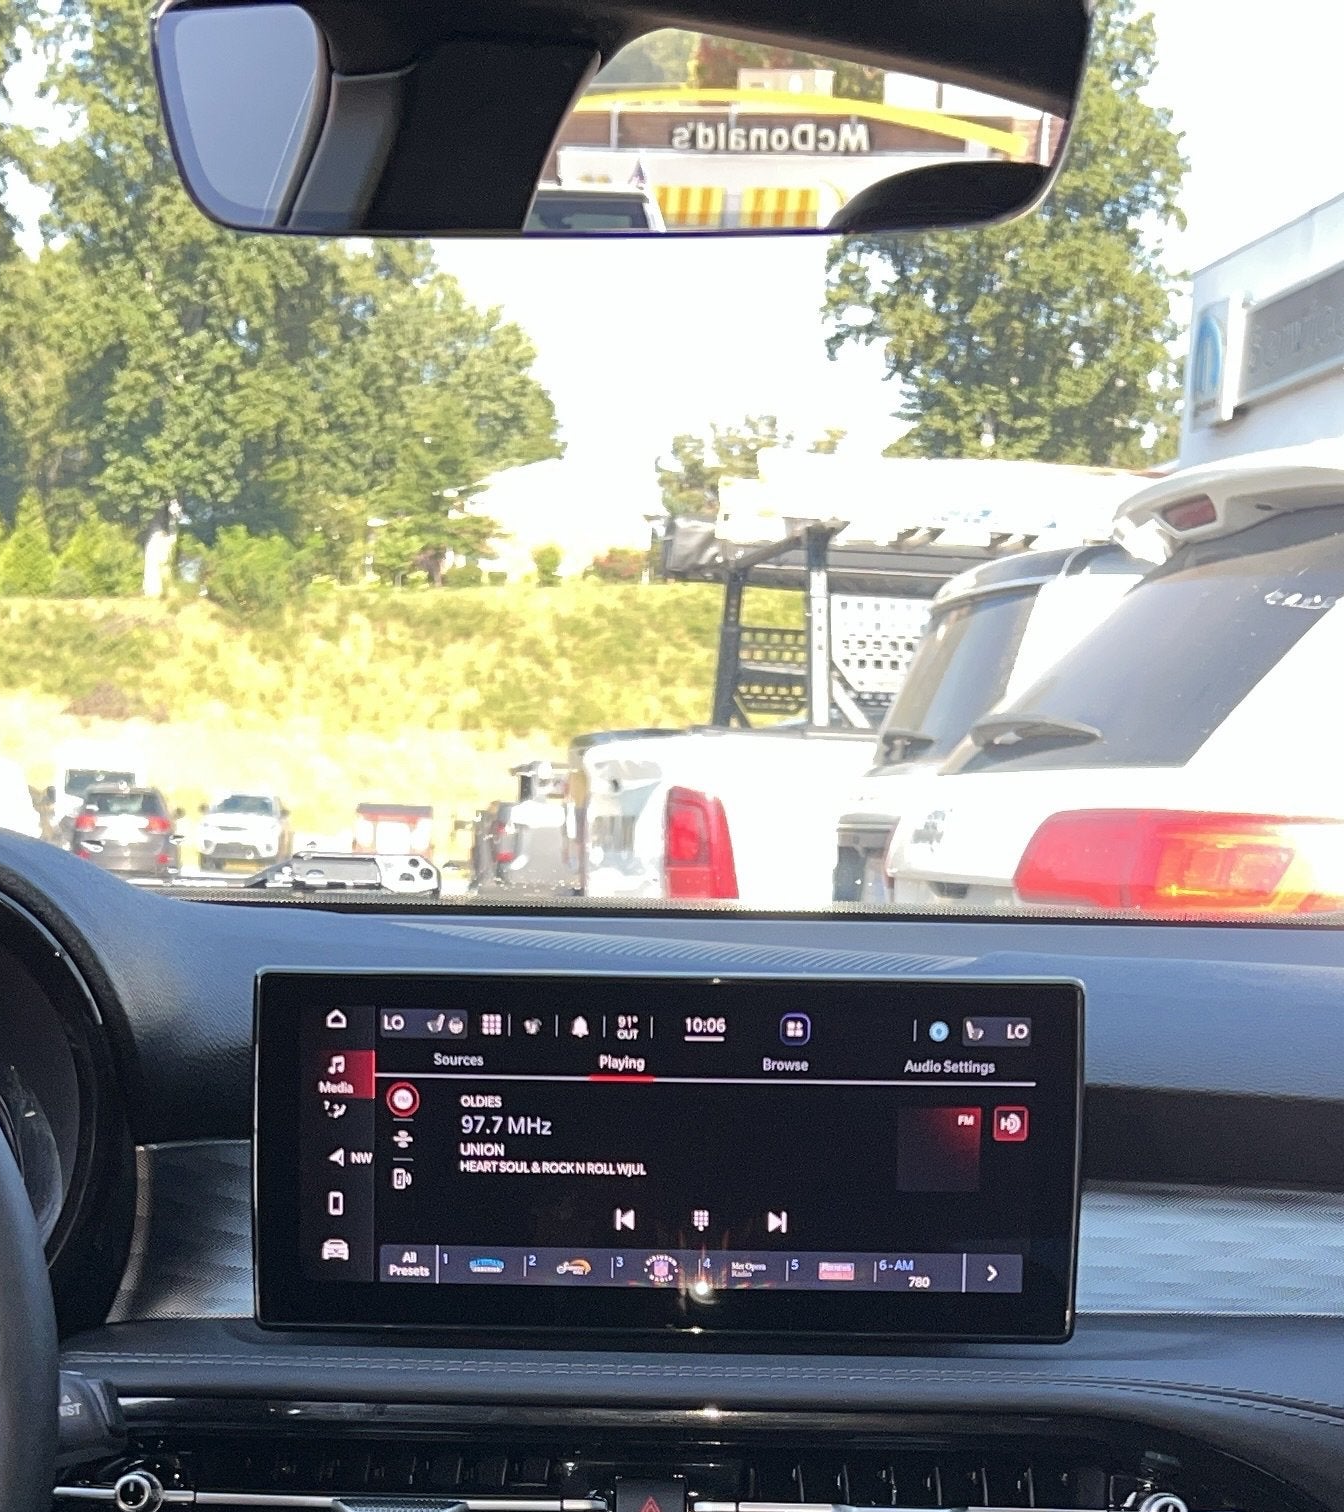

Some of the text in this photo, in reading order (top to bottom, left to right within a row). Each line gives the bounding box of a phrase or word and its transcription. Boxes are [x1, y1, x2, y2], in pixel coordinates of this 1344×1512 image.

[383, 1014, 405, 1031] LO
[684, 1017, 727, 1034] 10:06
[1006, 1023, 1030, 1040] LO
[433, 1052, 485, 1067] Sources
[599, 1054, 646, 1072] Playing
[762, 1057, 809, 1072] Browse
[903, 1059, 996, 1076] Audio Settings
[317, 1080, 354, 1095] Media
[459, 1094, 503, 1108] OLDIES
[460, 1114, 553, 1136] 97.7 MHz
[957, 1114, 975, 1126] FM
[459, 1142, 506, 1157] UNION
[349, 1151, 374, 1165] NW
[459, 1160, 499, 1174] HEART
[499, 1160, 531, 1174] SOUL
[531, 1161, 541, 1175] &
[541, 1162, 575, 1175] ROCK
[576, 1162, 586, 1175] N
[586, 1162, 617, 1176] ROLL
[401, 1251, 418, 1264] All
[528, 1254, 537, 1267] 2
[616, 1256, 625, 1268] 3
[702, 1257, 712, 1269] 4
[790, 1258, 800, 1271] 5
[389, 1264, 431, 1278] Presets
[908, 1276, 932, 1289] 780
